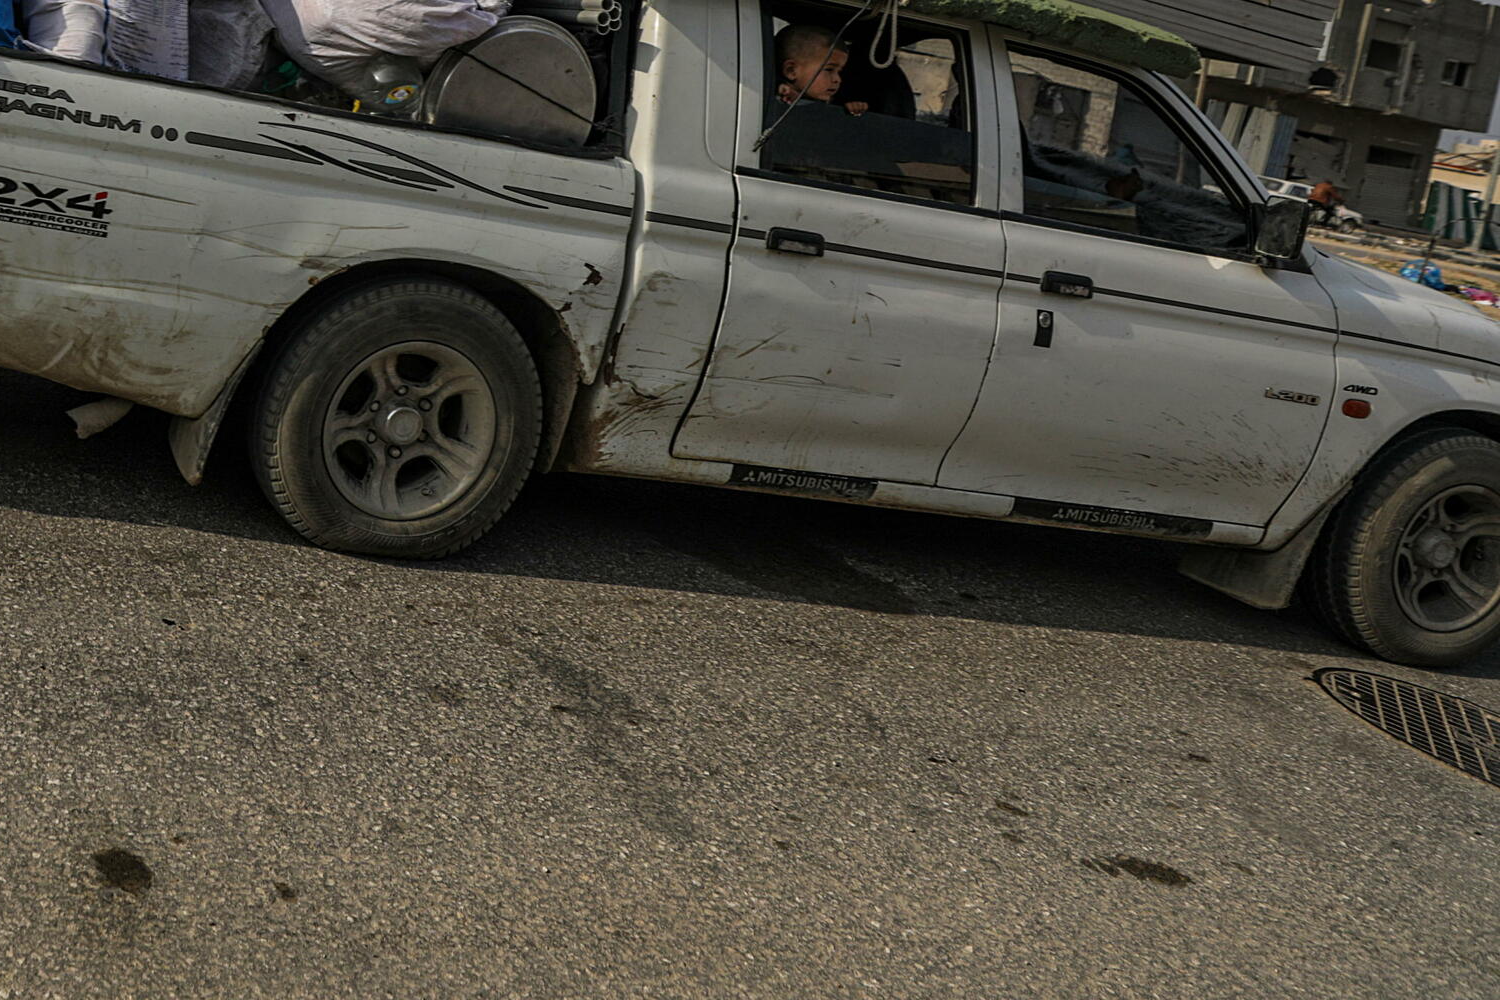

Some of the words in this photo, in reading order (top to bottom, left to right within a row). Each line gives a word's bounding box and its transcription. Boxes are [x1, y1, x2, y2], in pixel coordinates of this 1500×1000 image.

[1264, 386, 1321, 406] L200
[1343, 384, 1379, 396] 4WD
[757, 471, 848, 492] MITSUBISHI
[1065, 508, 1150, 529] MITSUBISHI
